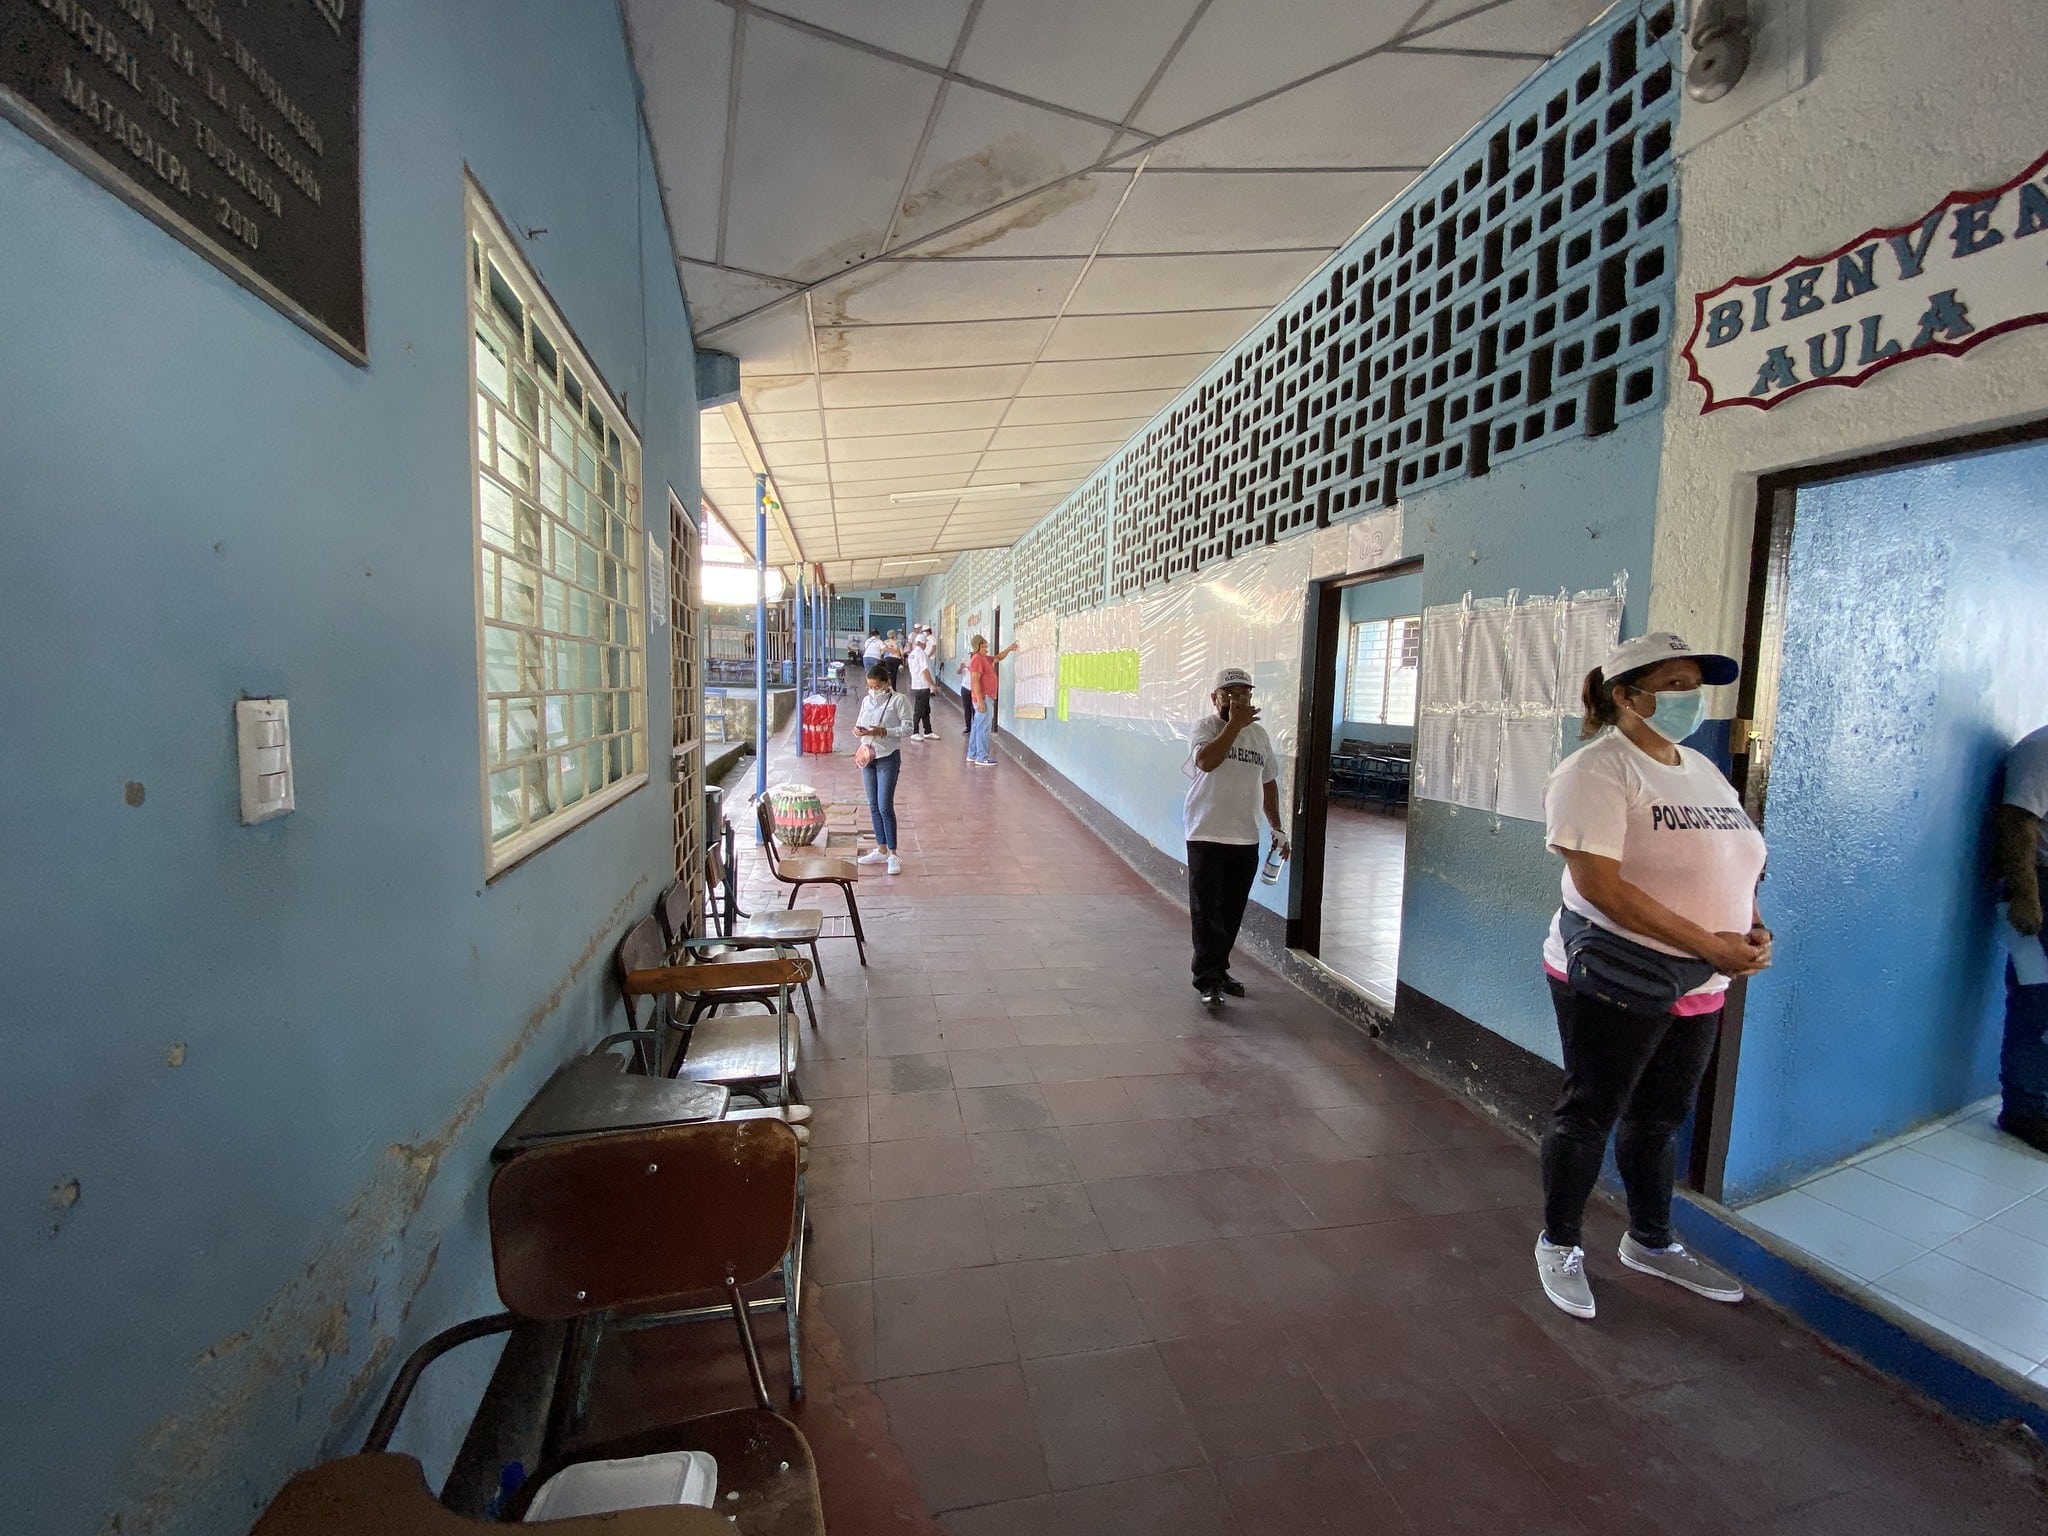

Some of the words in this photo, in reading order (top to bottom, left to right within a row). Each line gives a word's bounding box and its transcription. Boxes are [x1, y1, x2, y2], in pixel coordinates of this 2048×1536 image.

[62, 65, 192, 198] MATAGALPA
[1750, 288, 1976, 396] AULA
[1360, 531, 1383, 560] 02
[1652, 804, 1714, 831] POLICIA
